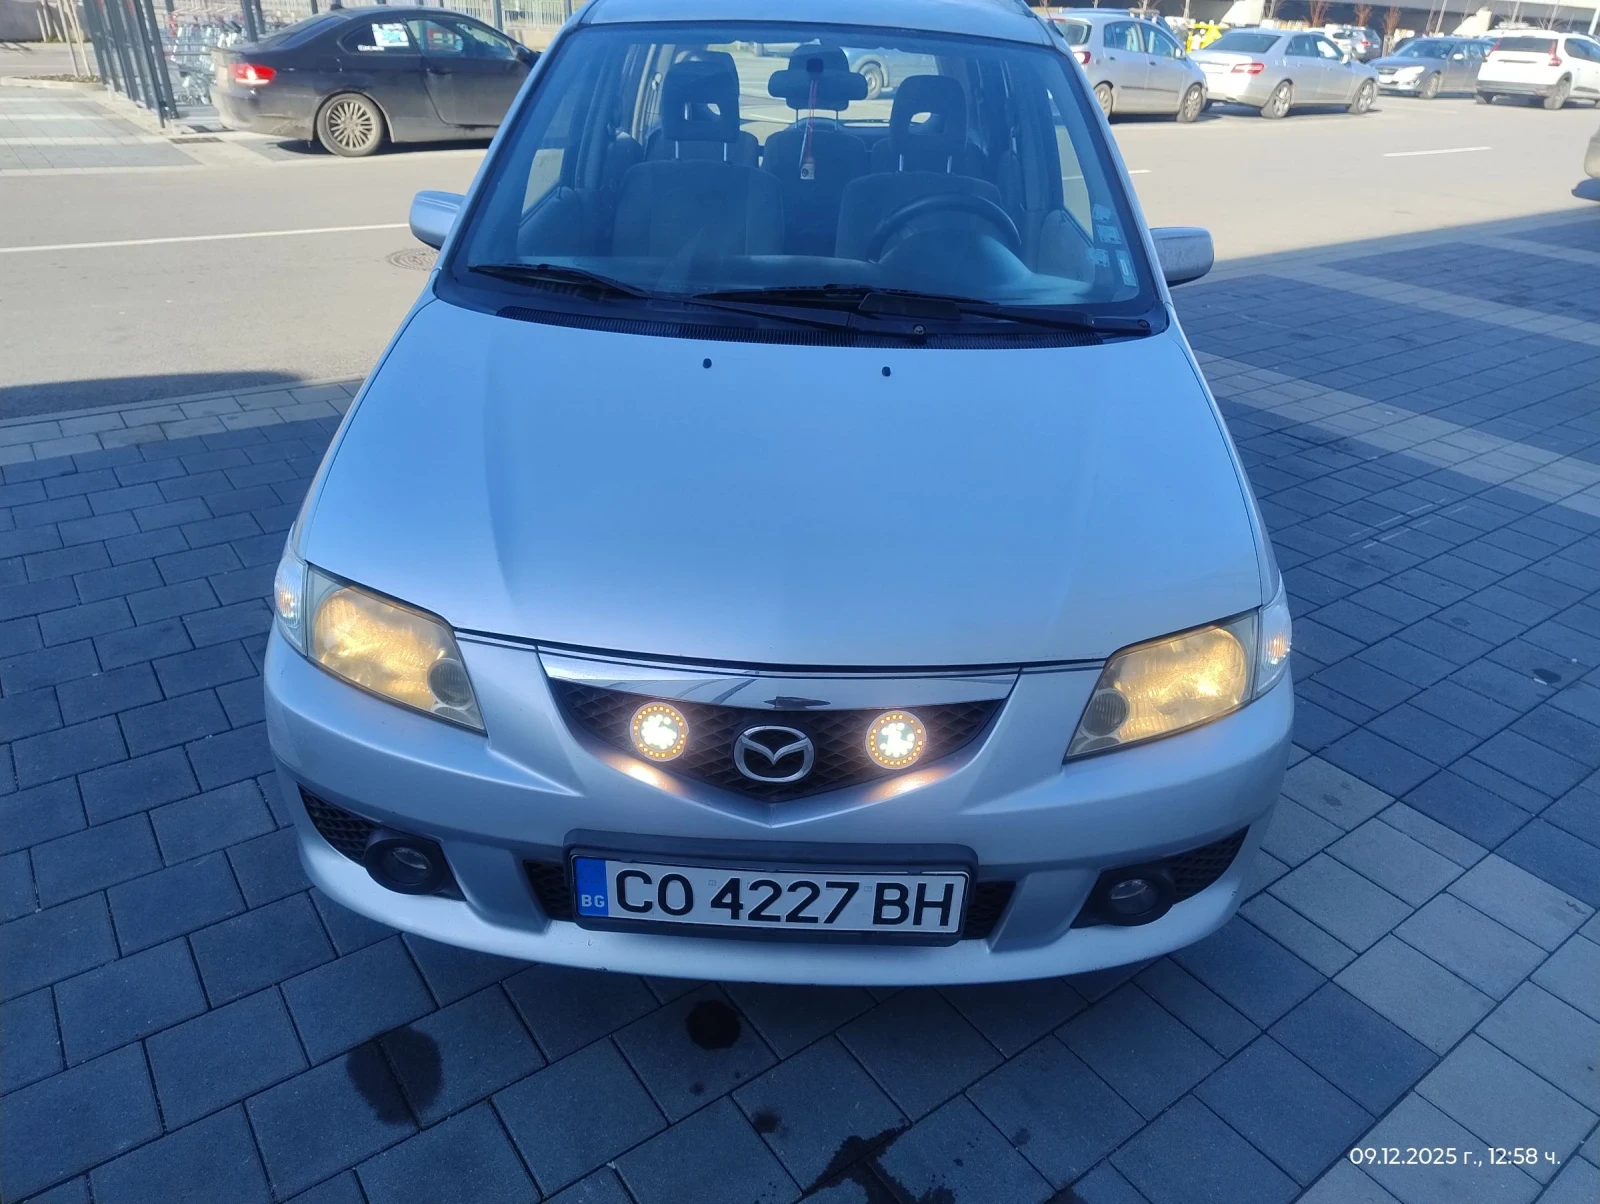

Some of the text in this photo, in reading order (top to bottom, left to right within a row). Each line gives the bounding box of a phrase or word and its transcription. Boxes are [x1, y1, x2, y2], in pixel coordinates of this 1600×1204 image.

[581, 894, 605, 908] BG
[616, 869, 955, 926] CO 4227 BH
